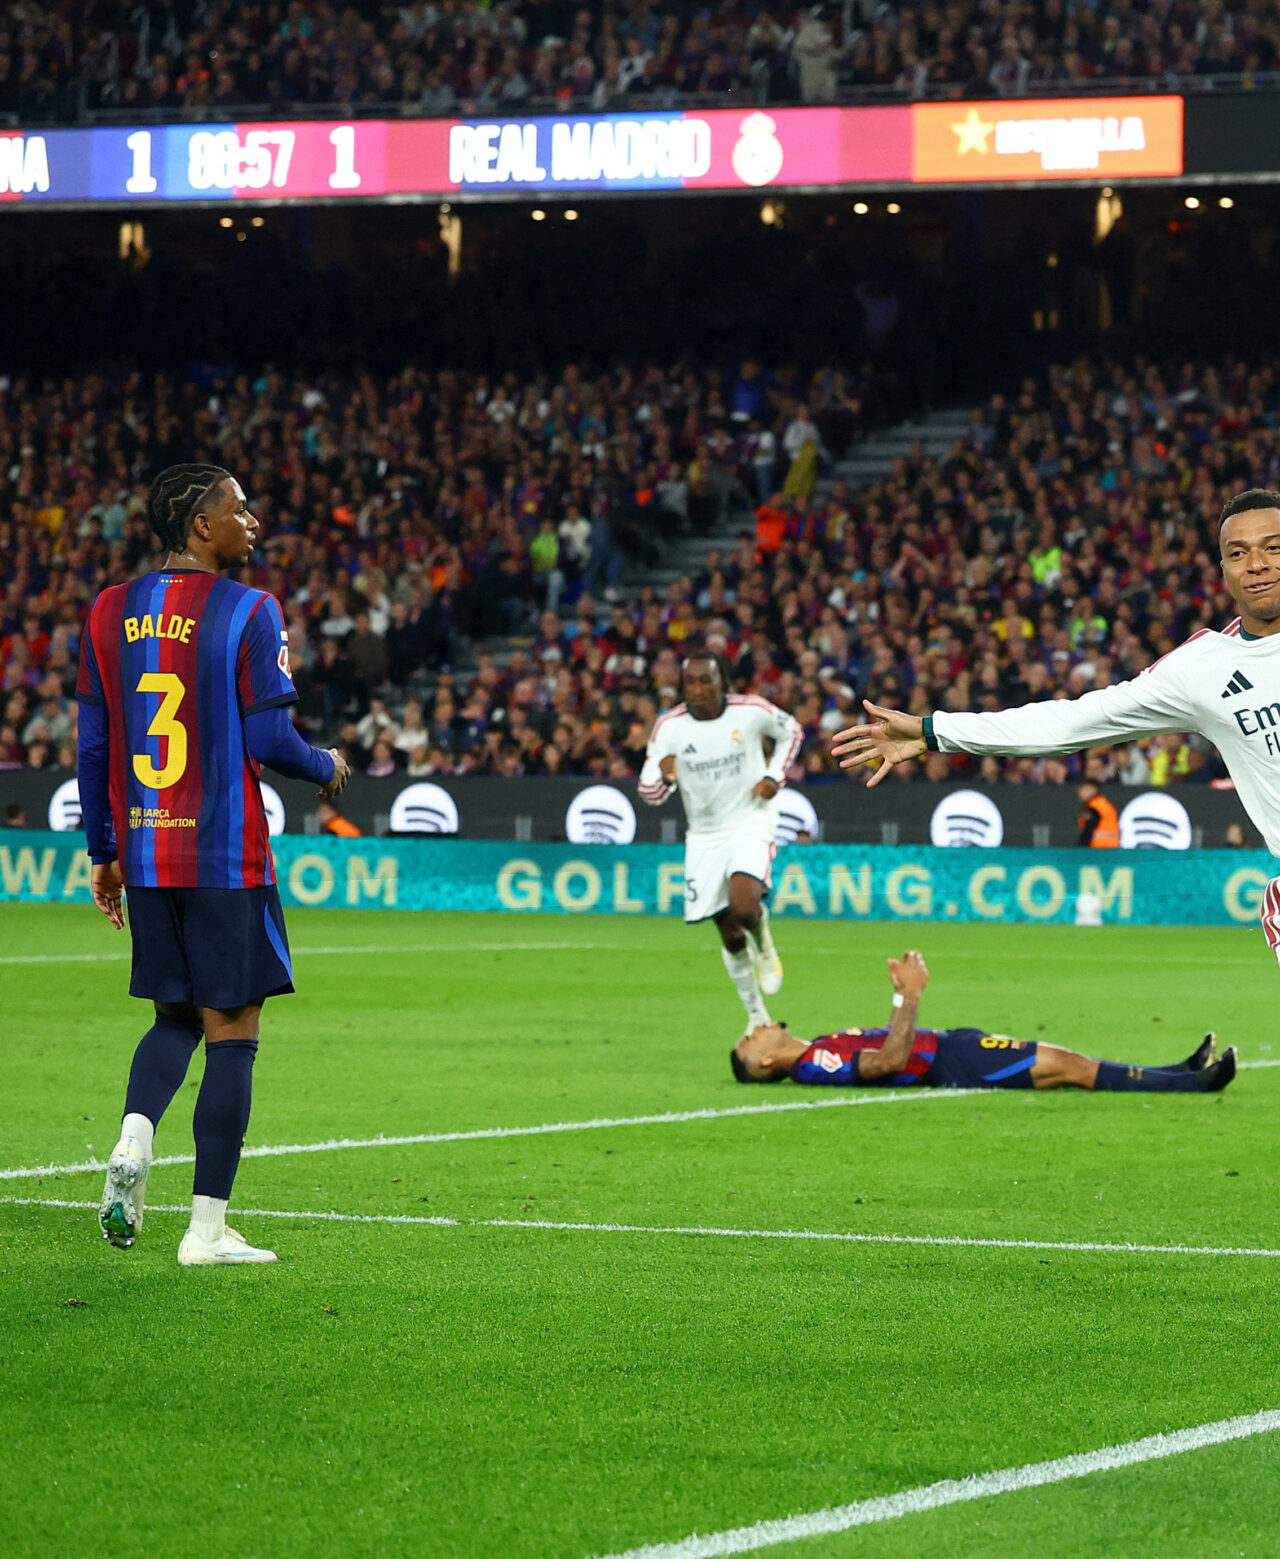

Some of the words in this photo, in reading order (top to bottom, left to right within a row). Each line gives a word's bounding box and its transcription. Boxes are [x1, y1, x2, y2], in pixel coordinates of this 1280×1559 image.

[125, 131, 157, 193] 1
[328, 126, 361, 189] 1
[449, 124, 546, 183] REAL
[552, 119, 711, 181] MADRID
[123, 613, 197, 644] BALDE
[132, 672, 188, 790] 3
[142, 818, 197, 828] FOUNDATION
[498, 859, 1133, 919] GOLFANG.COM
